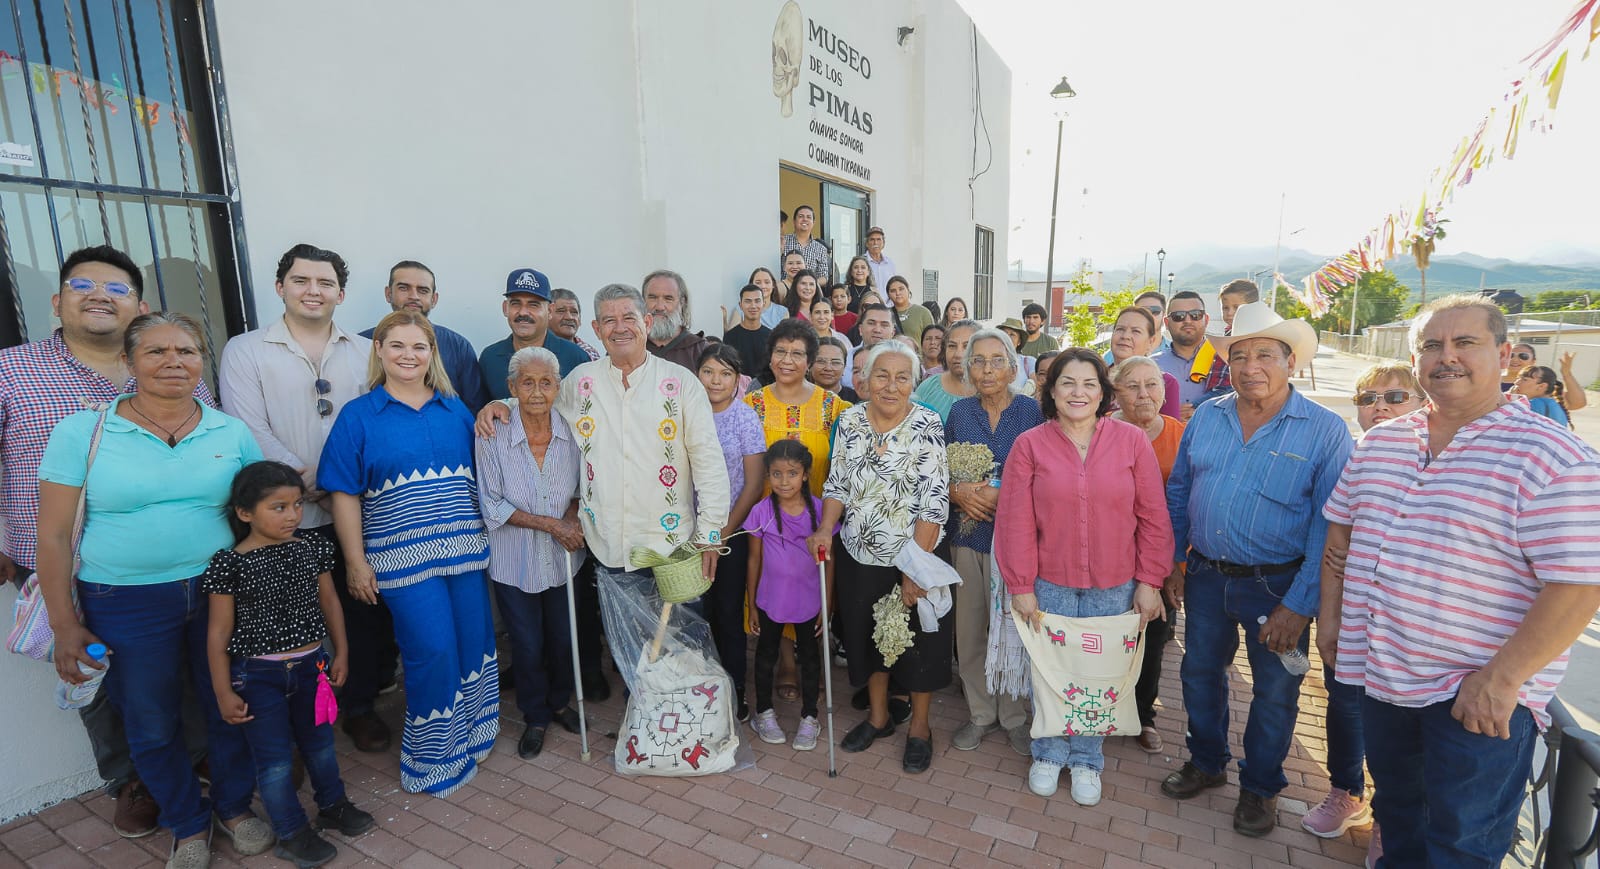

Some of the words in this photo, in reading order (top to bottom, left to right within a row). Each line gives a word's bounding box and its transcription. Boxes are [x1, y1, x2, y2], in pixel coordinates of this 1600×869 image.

[808, 18, 871, 79] MUSEO
[809, 55, 823, 75] DE
[825, 63, 843, 87] LOS
[808, 81, 873, 135] PIMAS
[839, 132, 864, 155] SONORA
